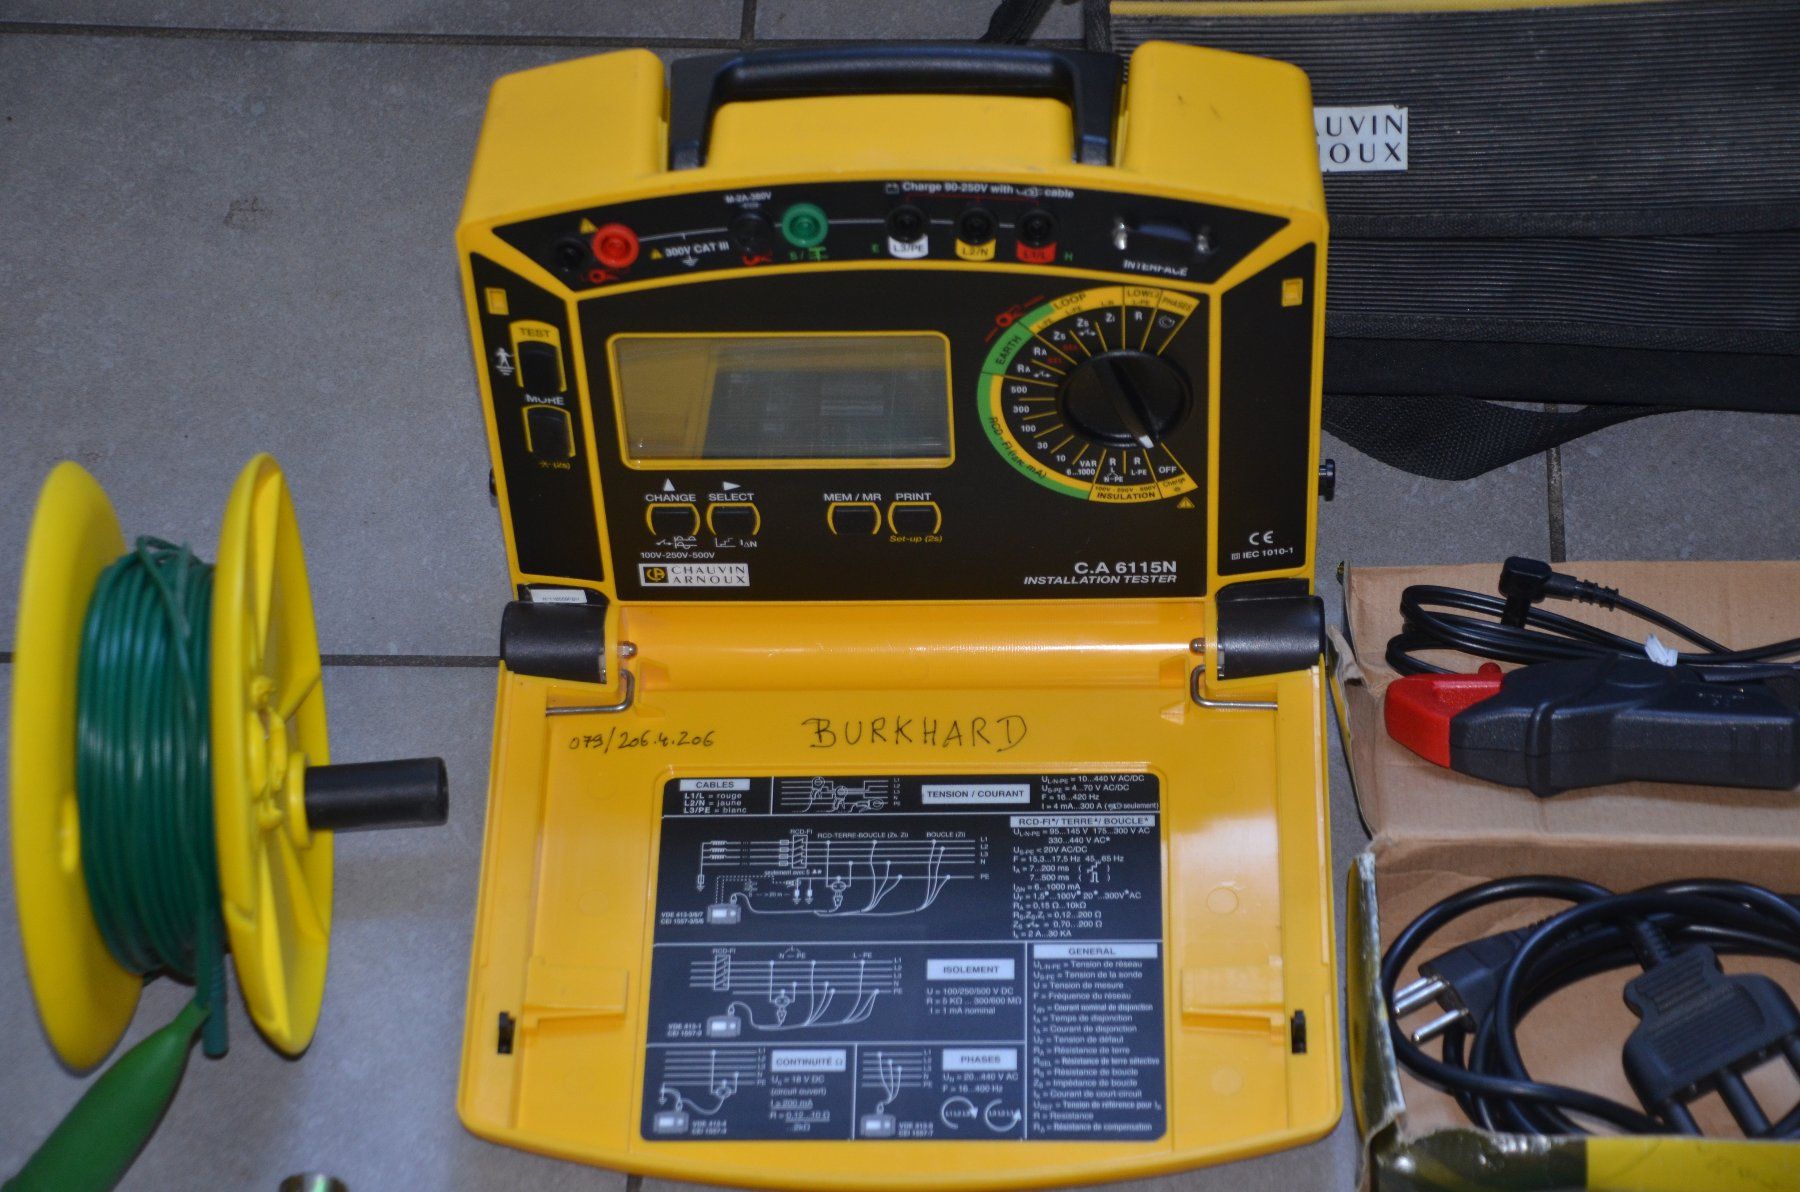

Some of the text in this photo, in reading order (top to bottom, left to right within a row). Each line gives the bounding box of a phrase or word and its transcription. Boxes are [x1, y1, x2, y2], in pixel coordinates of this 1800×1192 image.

[1314, 115, 1402, 136] UVIN
[902, 181, 942, 194] Charge
[990, 183, 1014, 194] with
[1044, 188, 1074, 199] cable
[693, 242, 720, 254] CAT
[1052, 292, 1087, 311] LOOP
[1134, 312, 1143, 321] R
[519, 326, 551, 338] TEST
[995, 334, 1022, 365] EARTH
[1010, 385, 1028, 394] 500
[1012, 405, 1030, 414] 300
[1020, 424, 1036, 432] 100
[1037, 442, 1048, 450] 30
[1056, 454, 1066, 462] 10
[1109, 458, 1116, 466] R
[1080, 460, 1097, 468] VAR
[1158, 466, 1178, 474] OFF
[645, 492, 754, 502] CHANGE SELECT
[824, 493, 853, 501] MEM
[862, 493, 882, 502] MR
[895, 492, 932, 501] PRINT
[1096, 492, 1156, 500] INSULATION
[1242, 546, 1294, 560] IEC 1010-1
[671, 566, 746, 575] CHAUVIN
[1117, 560, 1177, 574] 6115N
[672, 576, 746, 584] ARNOUX
[1024, 574, 1177, 585] INSTALLATION TESTER
[802, 714, 1028, 753] BURKHARD
[695, 781, 735, 789] CABLES
[1102, 784, 1130, 792] AC/DC
[716, 792, 742, 800] rouge
[928, 790, 969, 798] TENSION
[977, 790, 1024, 798] COURANT
[1071, 960, 1101, 968] Tension
[1115, 960, 1142, 968] réseau
[944, 966, 999, 974] ISOLEMENT
